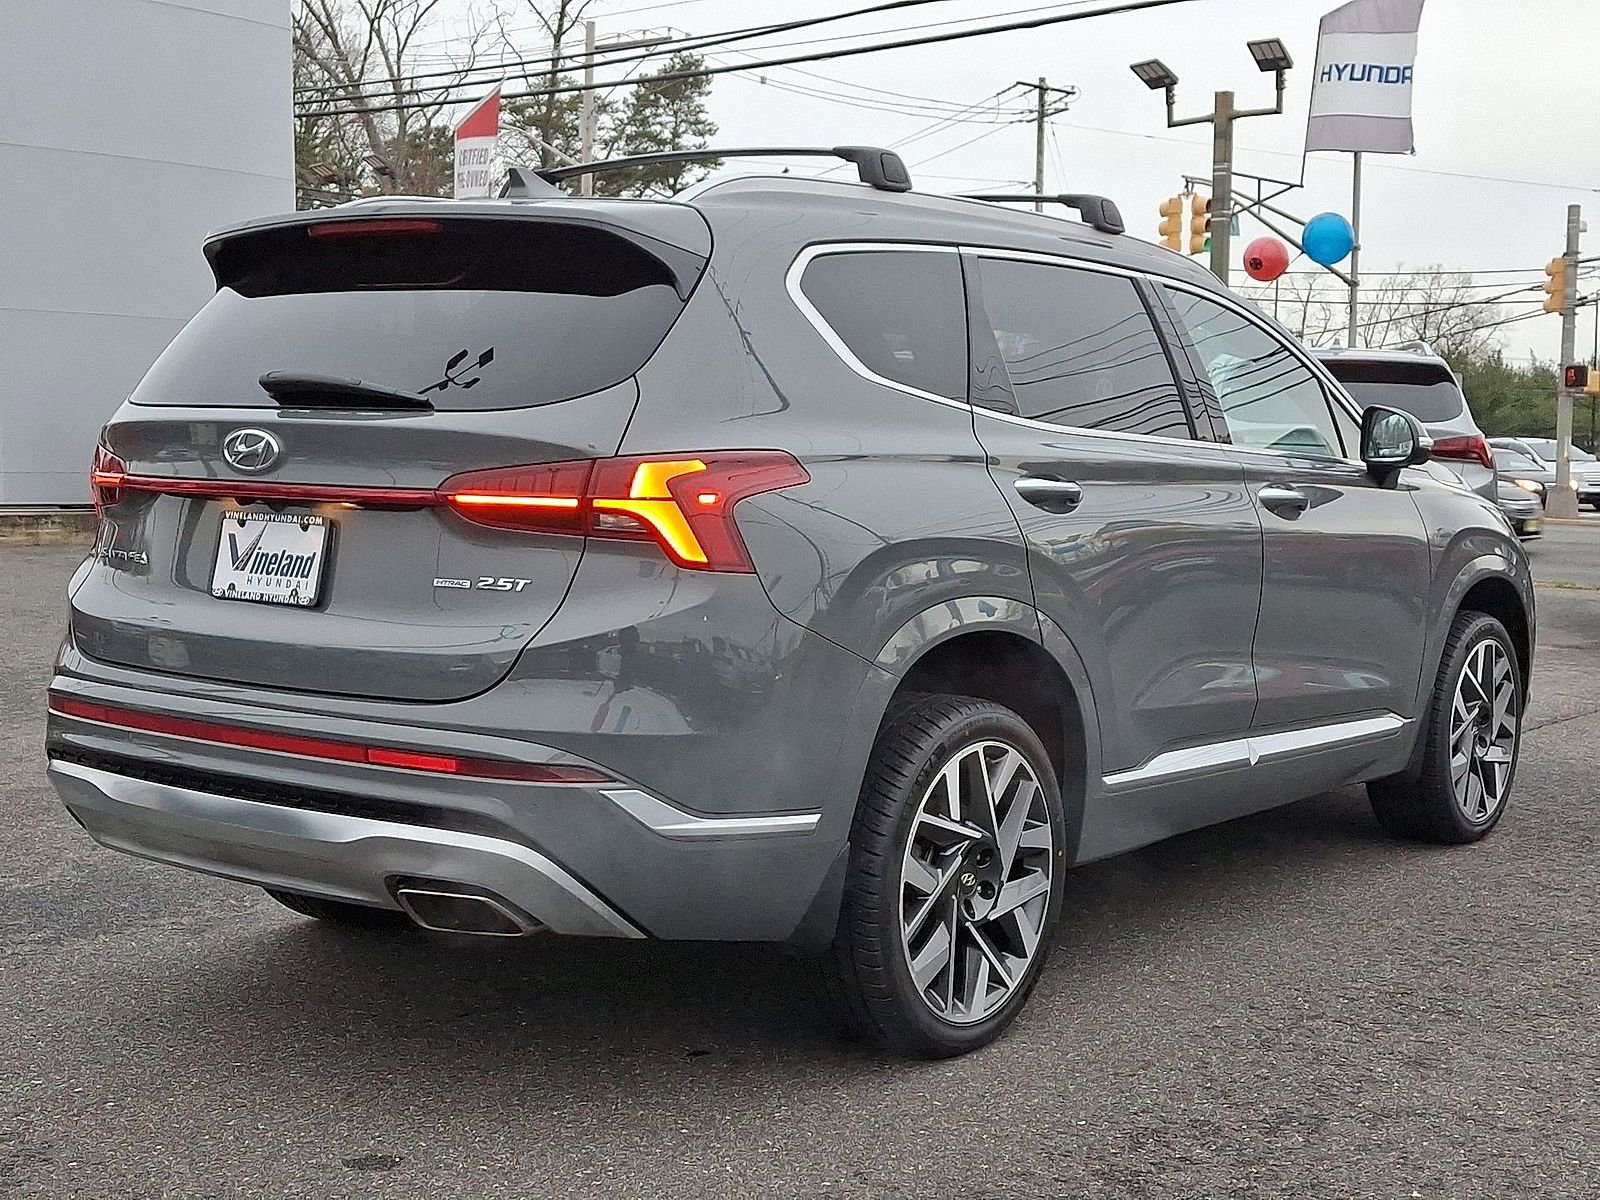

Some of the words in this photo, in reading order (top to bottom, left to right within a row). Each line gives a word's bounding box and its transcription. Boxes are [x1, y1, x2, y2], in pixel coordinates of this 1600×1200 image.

[225, 511, 323, 525] VINELANDHYUNDAI.COM
[228, 521, 317, 579] Vineland
[246, 575, 309, 591] HYUNDAI
[434, 579, 471, 588] HTRAC
[224, 588, 262, 601] VINELAND
[262, 592, 298, 605] HYUNDAI
